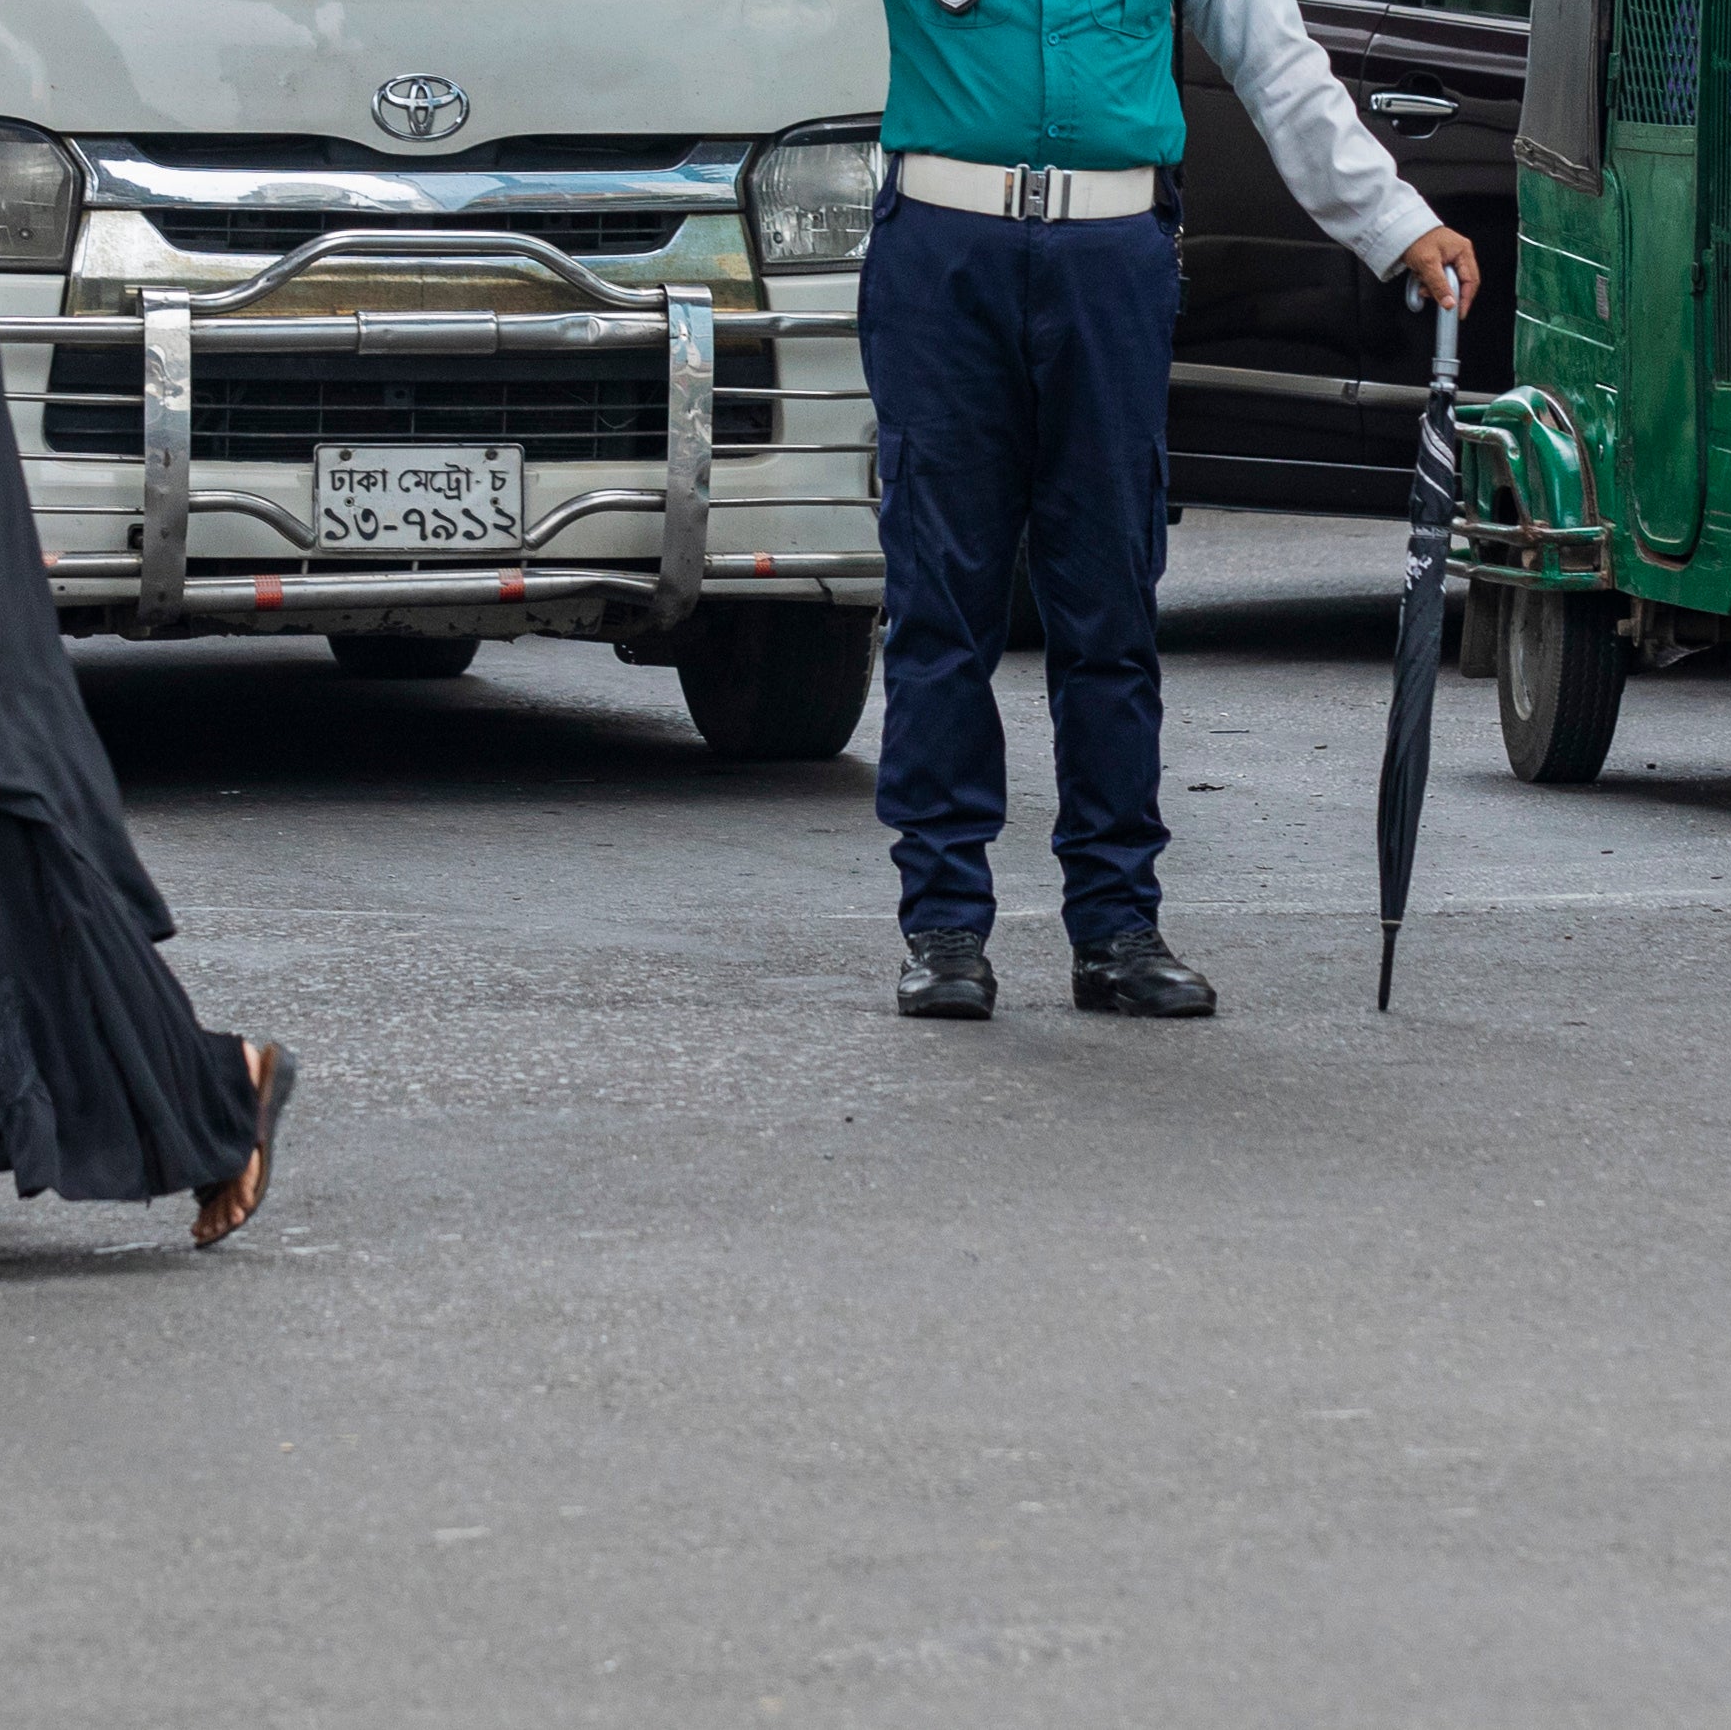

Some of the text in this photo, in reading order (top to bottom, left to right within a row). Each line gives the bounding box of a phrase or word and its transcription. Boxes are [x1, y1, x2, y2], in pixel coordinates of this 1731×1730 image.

[330, 468, 389, 493] ঢাকা
[488, 469, 509, 492] চ
[323, 506, 518, 542] ১৩-৭৯১২
